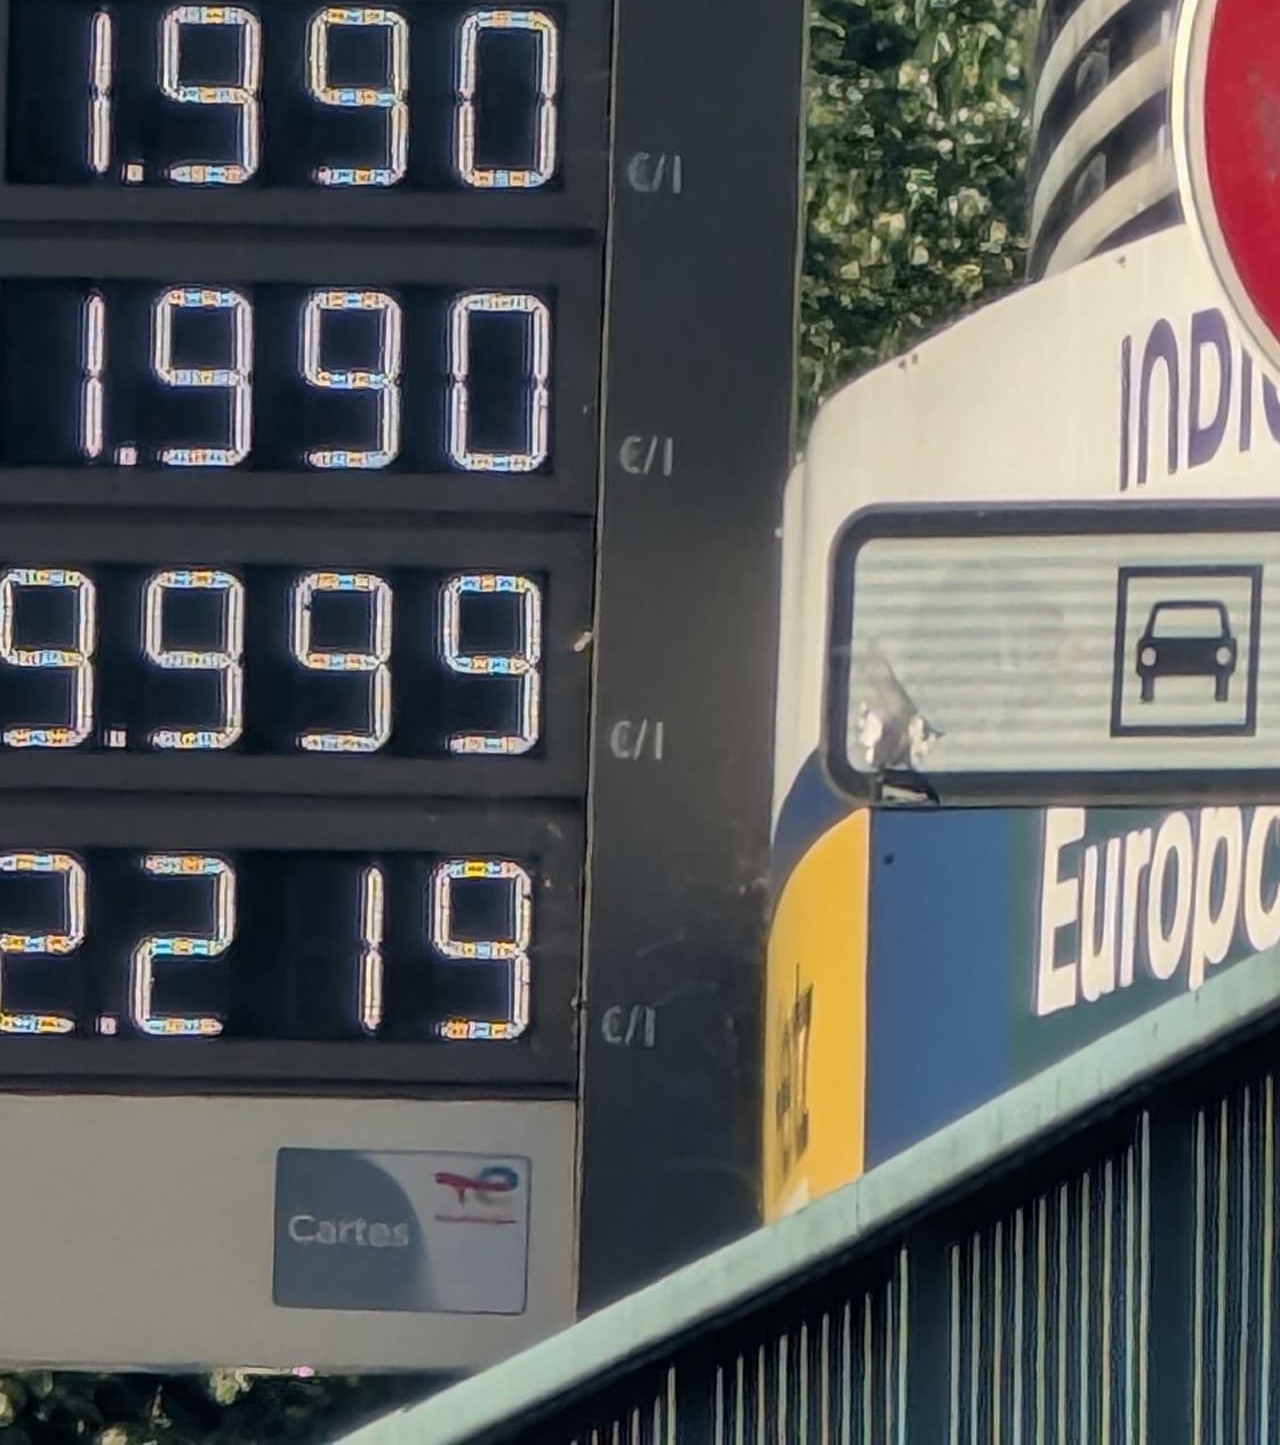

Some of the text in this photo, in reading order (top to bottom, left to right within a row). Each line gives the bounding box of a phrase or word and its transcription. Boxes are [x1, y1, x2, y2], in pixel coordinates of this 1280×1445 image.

[86, 3, 561, 191] 1.990
[80, 286, 554, 474] 1.990
[286, 1213, 410, 1248] Cartes
